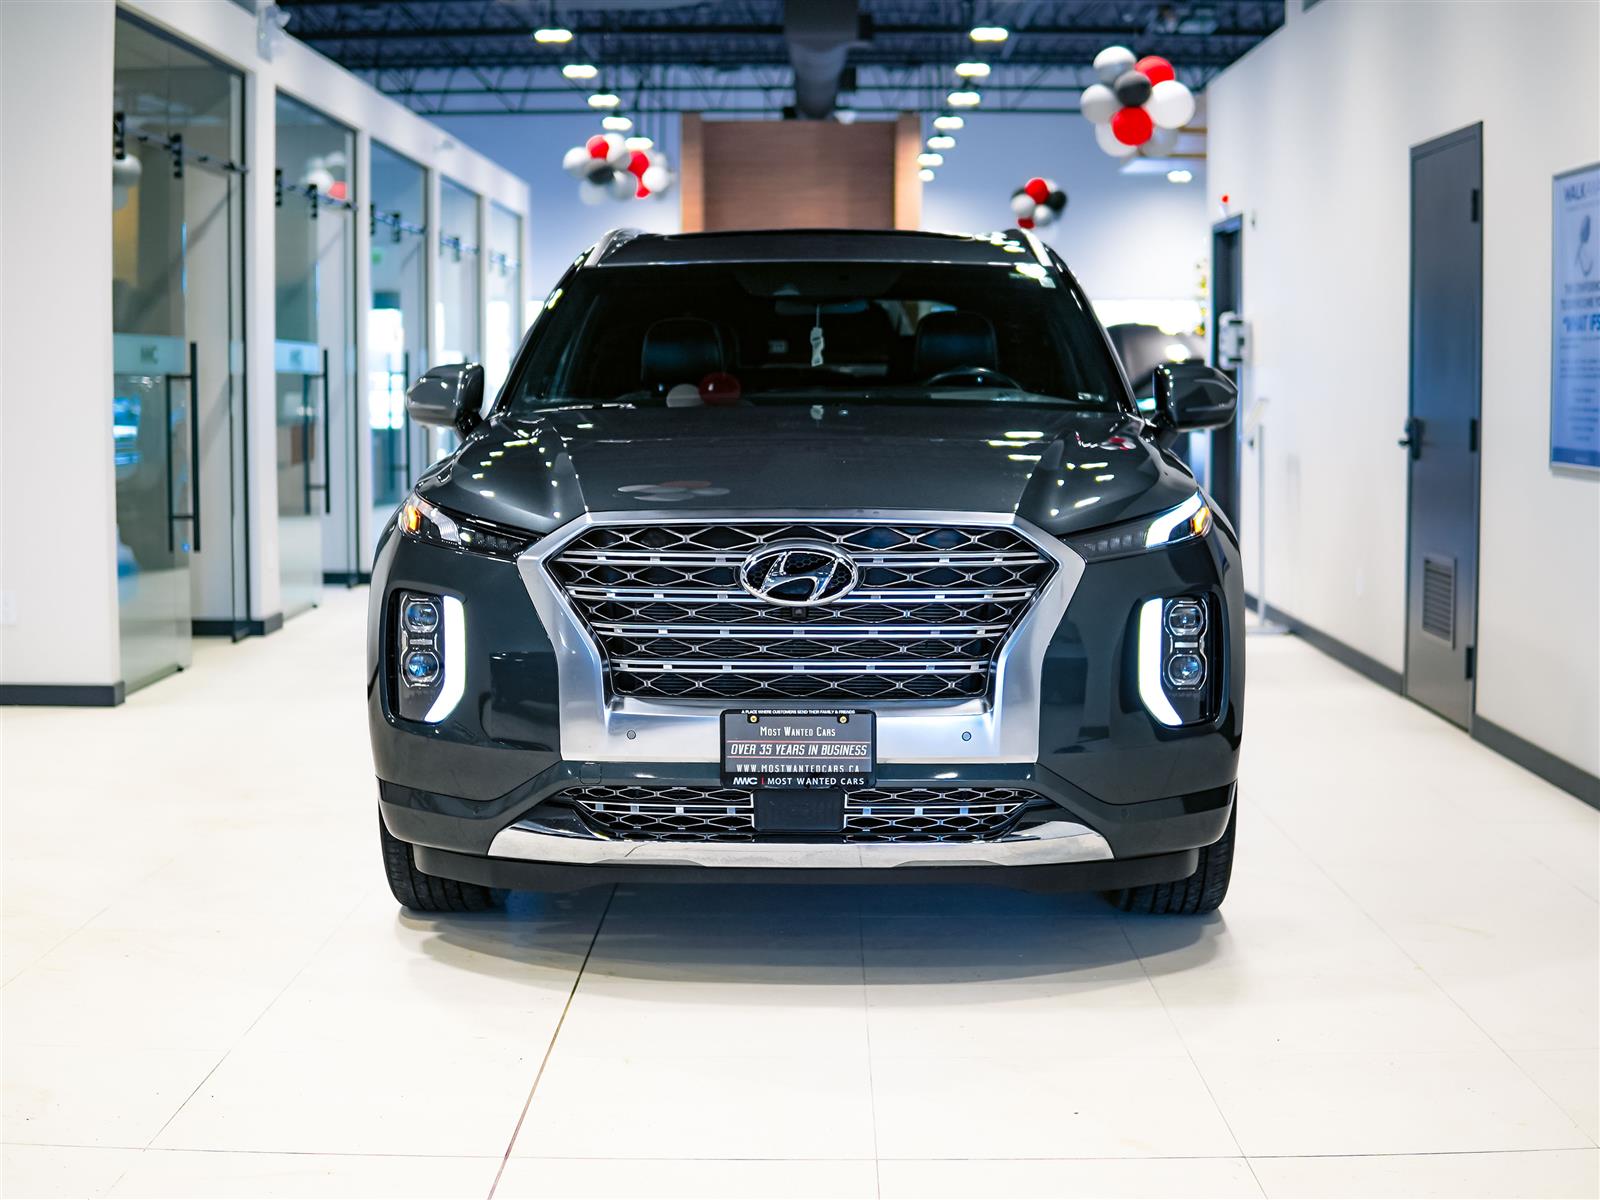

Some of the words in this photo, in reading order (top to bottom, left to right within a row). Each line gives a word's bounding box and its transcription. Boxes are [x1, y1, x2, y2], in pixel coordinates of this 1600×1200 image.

[760, 726, 781, 737] MOST
[784, 726, 813, 737] WANTED
[816, 726, 836, 737] CARS
[730, 743, 757, 756] OVER
[759, 744, 773, 755] 35
[775, 744, 806, 756] YEARS
[808, 744, 820, 756] IN
[821, 744, 868, 756] BUSINESS
[736, 764, 860, 773] WWW.MOSTWANTEDCARSCA
[767, 777, 793, 786] MOST
[796, 777, 837, 786] WANTED
[840, 777, 865, 786] CARS
